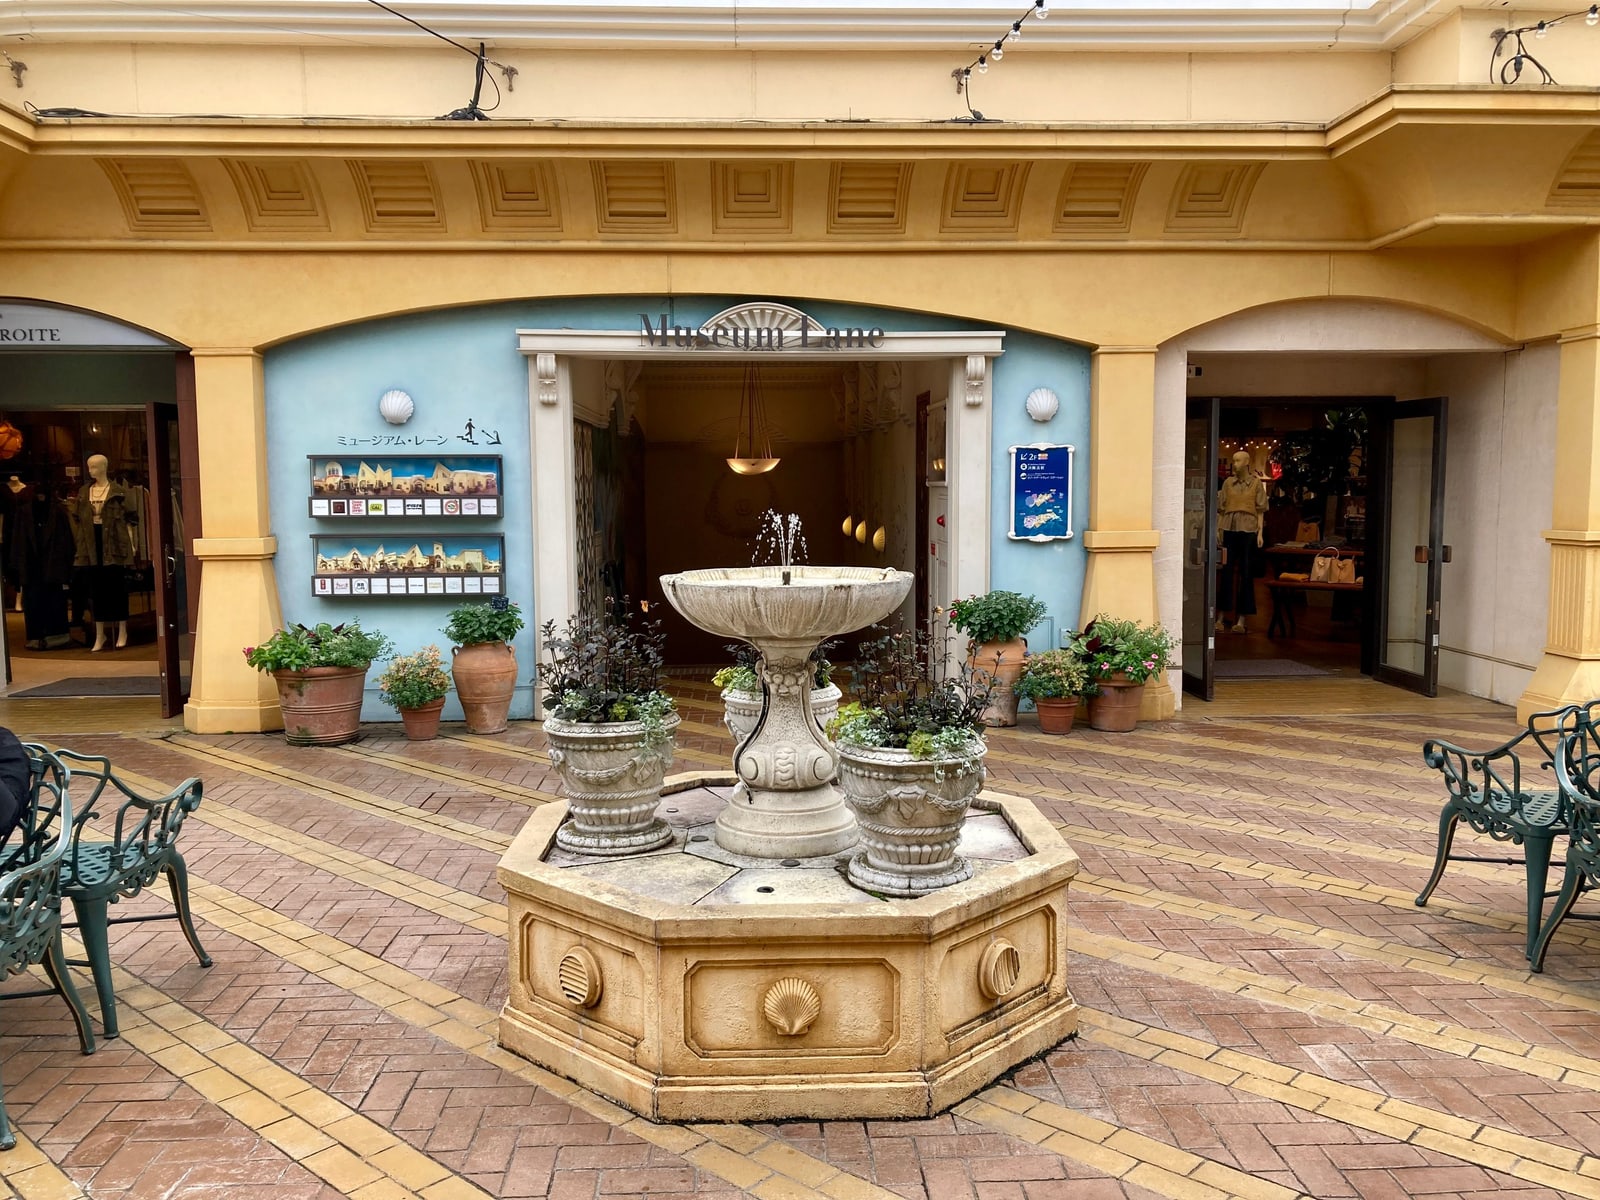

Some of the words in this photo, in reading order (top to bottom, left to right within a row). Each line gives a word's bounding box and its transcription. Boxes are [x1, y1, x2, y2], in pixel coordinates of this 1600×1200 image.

[637, 313, 784, 349] Museum
[799, 314, 885, 349] Lane
[337, 435, 448, 446] ミュージアム・レーン
